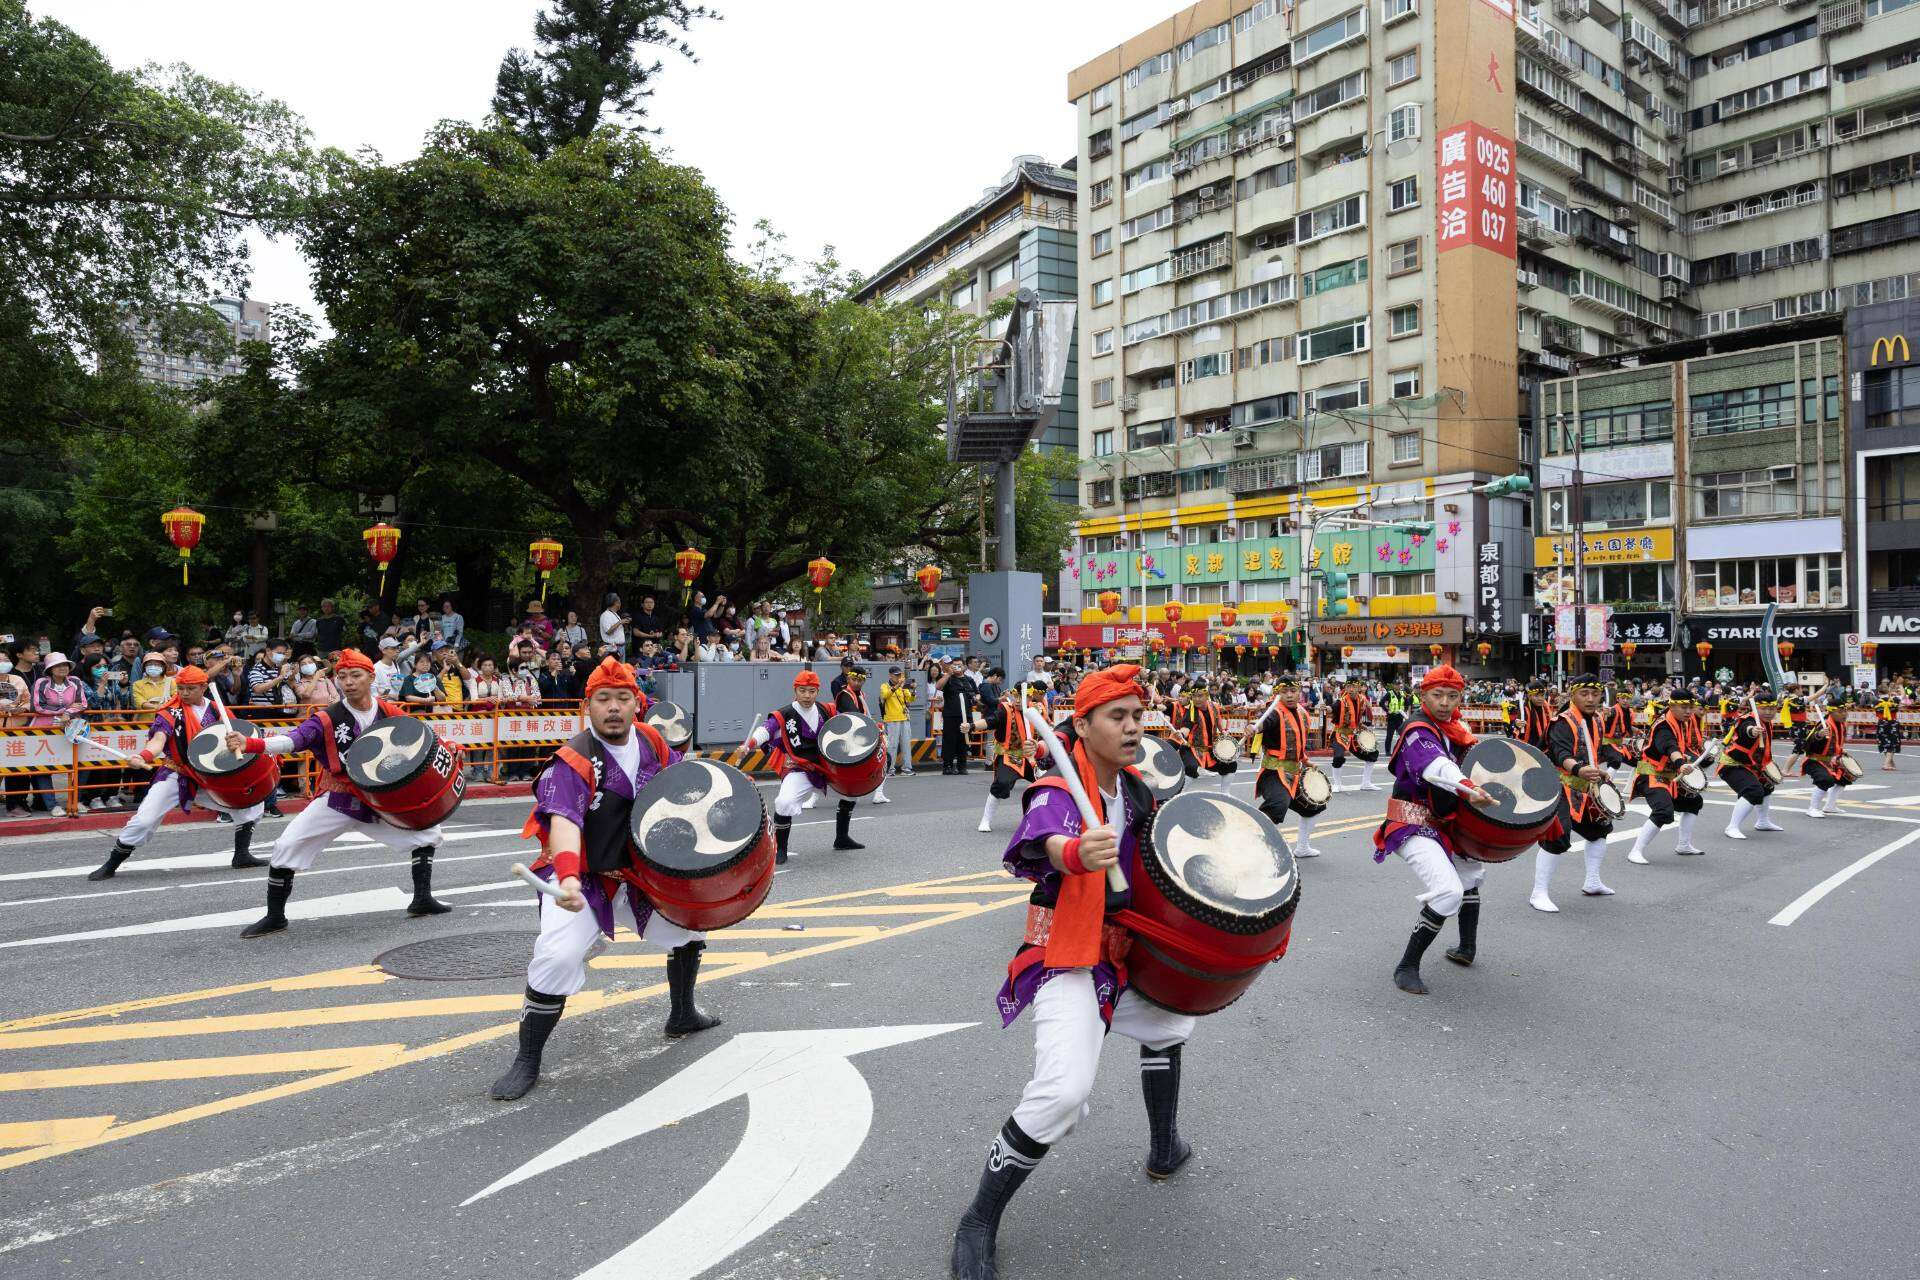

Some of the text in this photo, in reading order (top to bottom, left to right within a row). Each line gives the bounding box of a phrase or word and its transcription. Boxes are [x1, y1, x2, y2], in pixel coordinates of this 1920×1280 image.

[1476, 135, 1510, 176] 0925
[1440, 130, 1468, 241] 廣告洽
[1481, 174, 1506, 209] 460
[1481, 208, 1506, 243] 037
[1020, 623, 1033, 662] 北投
[1319, 622, 1444, 638] Carrefour 家樂福
[1707, 626, 1819, 639] STARUCKS
[509, 719, 573, 734] 車輛改道
[5, 739, 56, 758] 進入
[91, 734, 149, 752] 車輛
